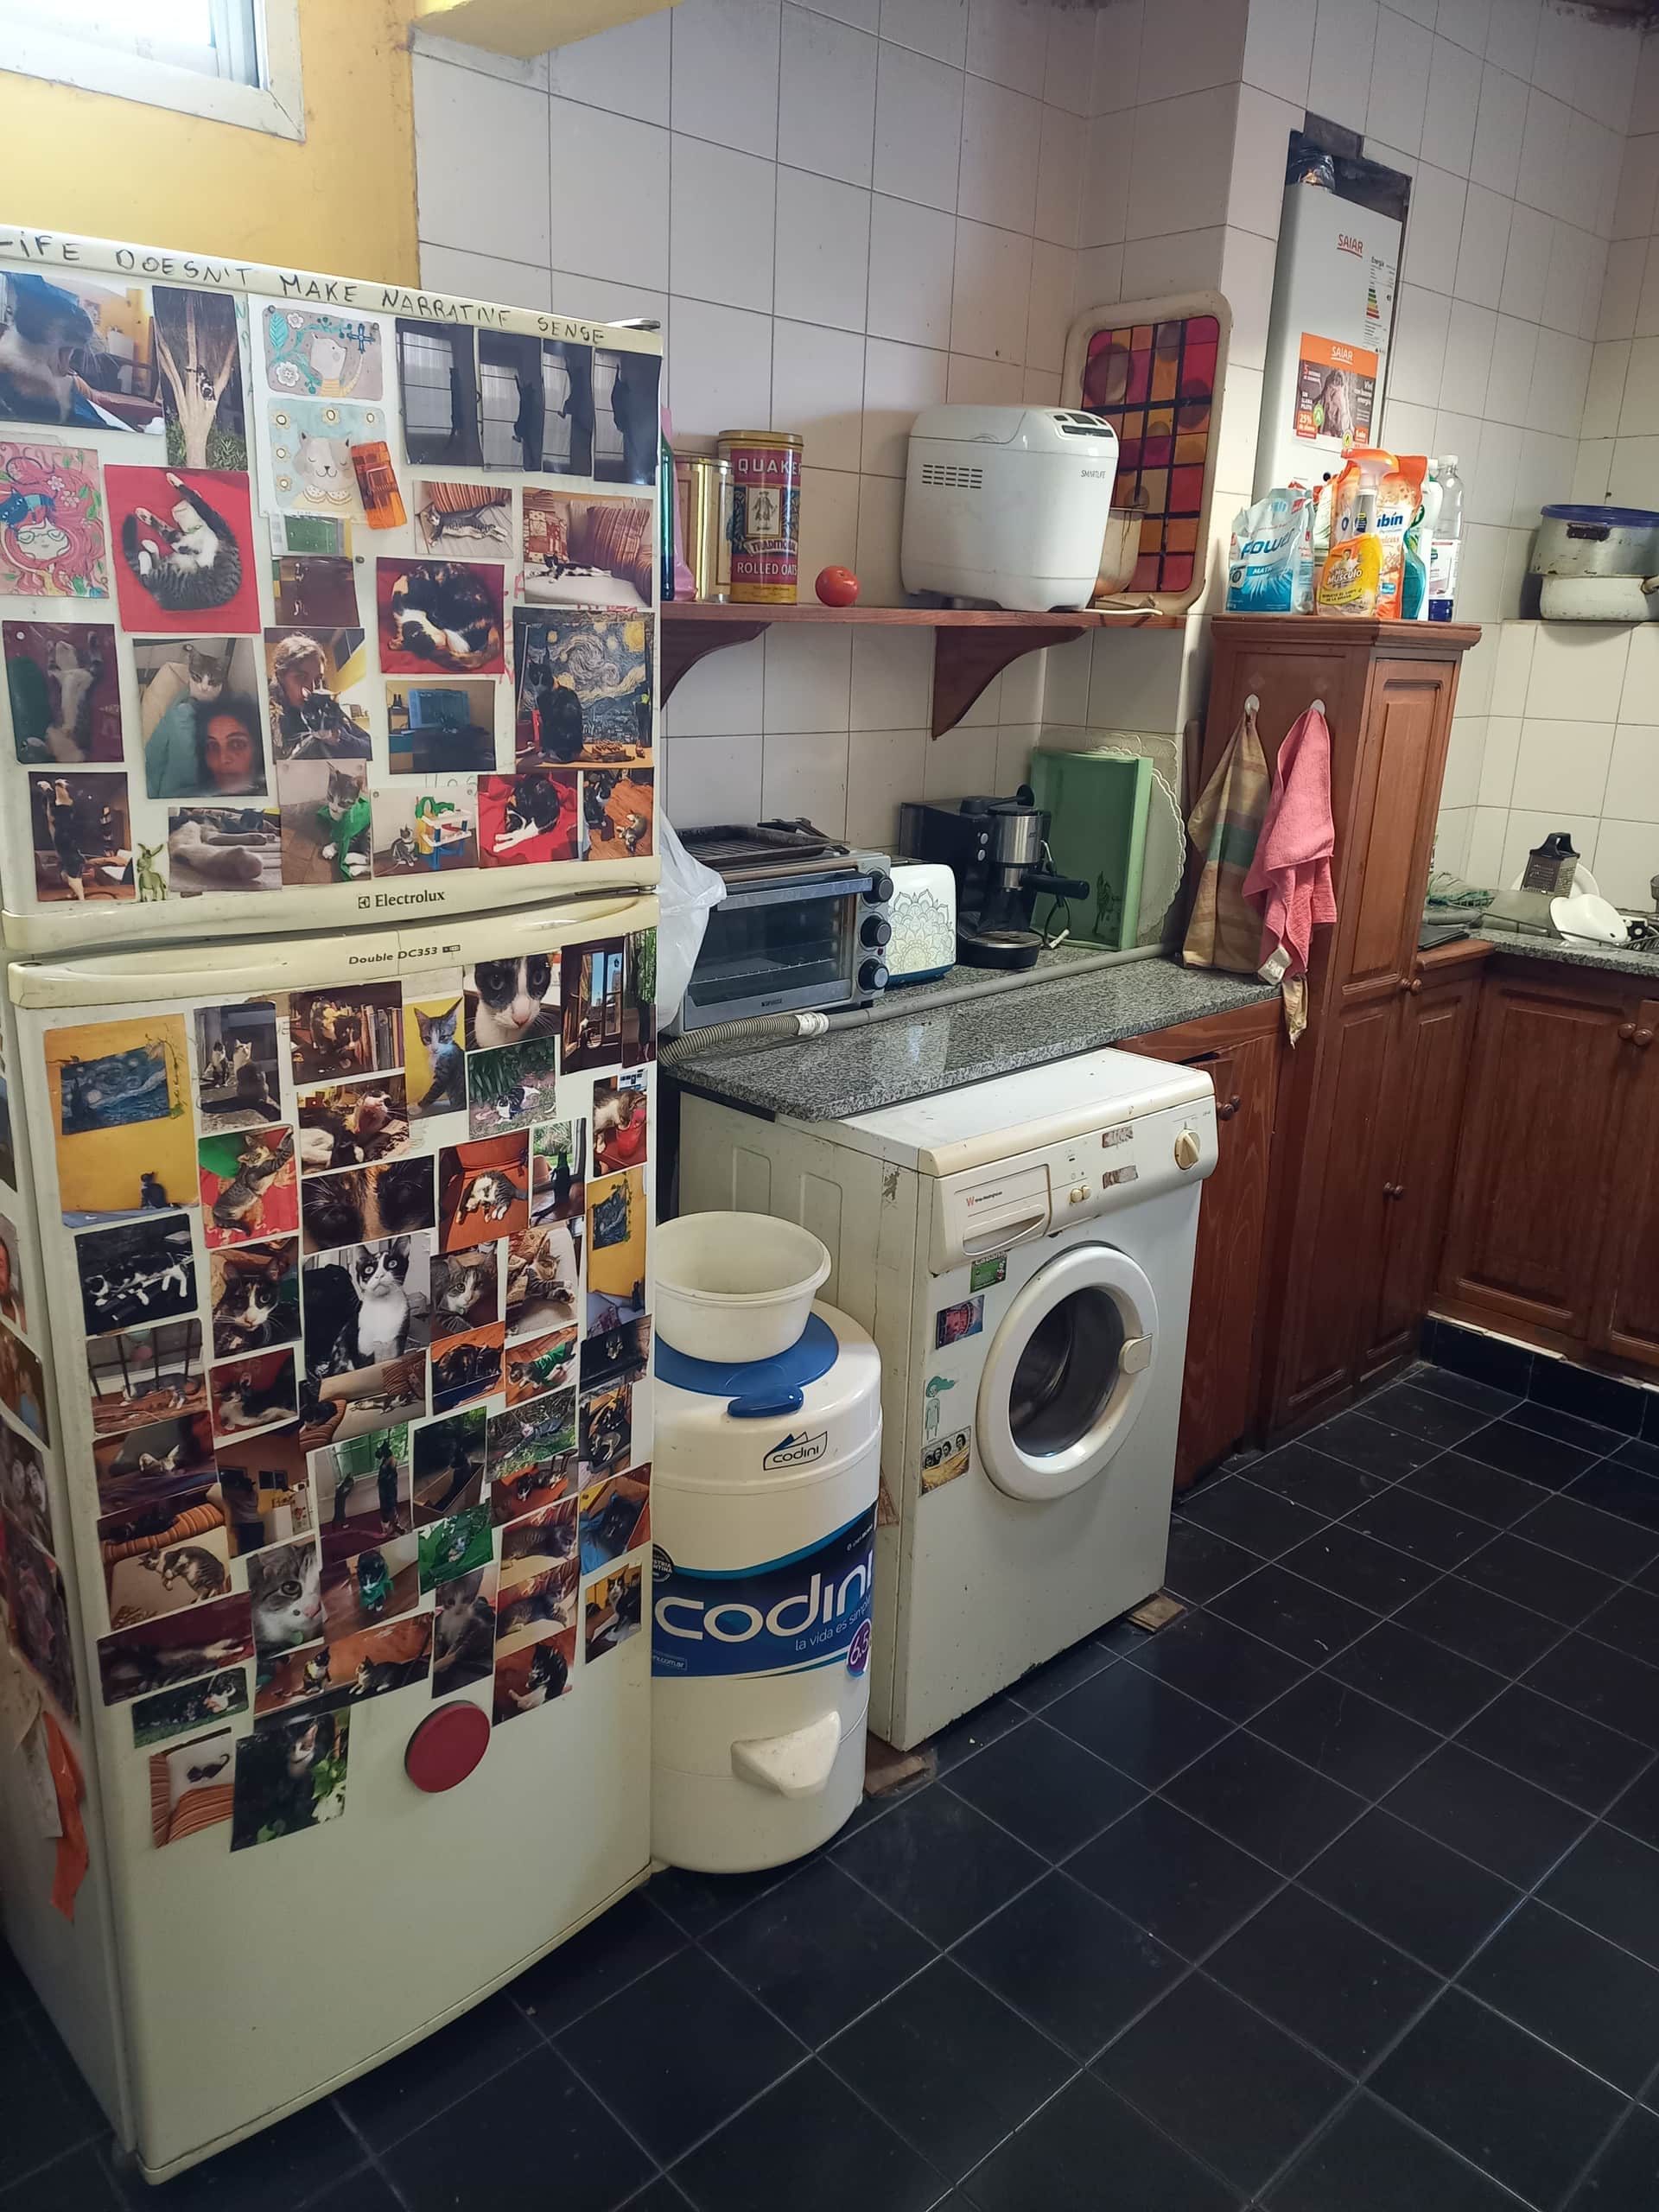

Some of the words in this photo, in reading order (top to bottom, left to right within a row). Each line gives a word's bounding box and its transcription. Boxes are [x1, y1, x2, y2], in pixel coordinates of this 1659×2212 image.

[1338, 233, 1363, 254] SAIAR
[116, 249, 253, 286] DOESN'T
[279, 273, 358, 302] MAKE
[537, 316, 605, 345] SENSE
[1332, 346, 1353, 361] SAIAR
[737, 562, 779, 575] ROLLED
[781, 563, 798, 576] OATS
[375, 889, 446, 907] Electrolux
[348, 952, 394, 965] Double
[397, 946, 438, 960] DC353
[772, 1445, 819, 1464] codini
[654, 1549, 874, 1643] codini
[795, 1638, 806, 1652] la
[810, 1628, 834, 1645] vida
[836, 1621, 848, 1633] es
